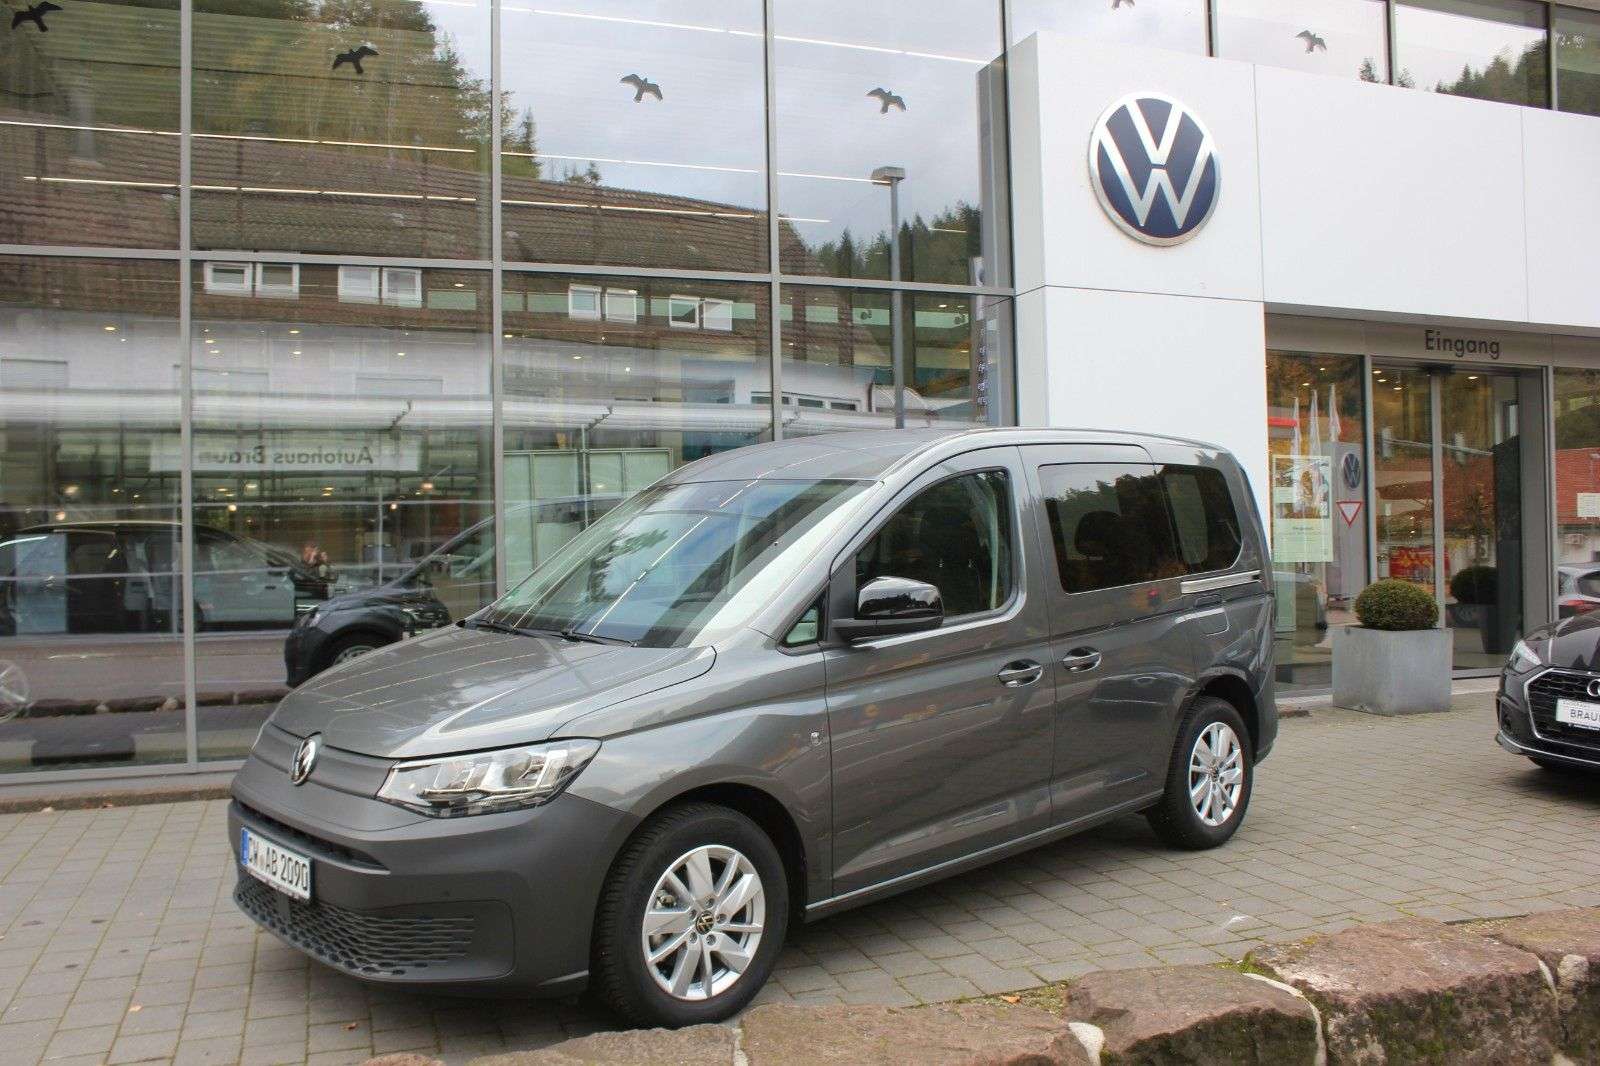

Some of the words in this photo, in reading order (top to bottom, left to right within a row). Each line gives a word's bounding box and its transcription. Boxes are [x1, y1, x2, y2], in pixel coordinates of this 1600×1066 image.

[1094, 95, 1218, 236] VW
[1424, 329, 1500, 360] Eingang
[265, 846, 278, 877] AB
[280, 853, 308, 892] 2090
